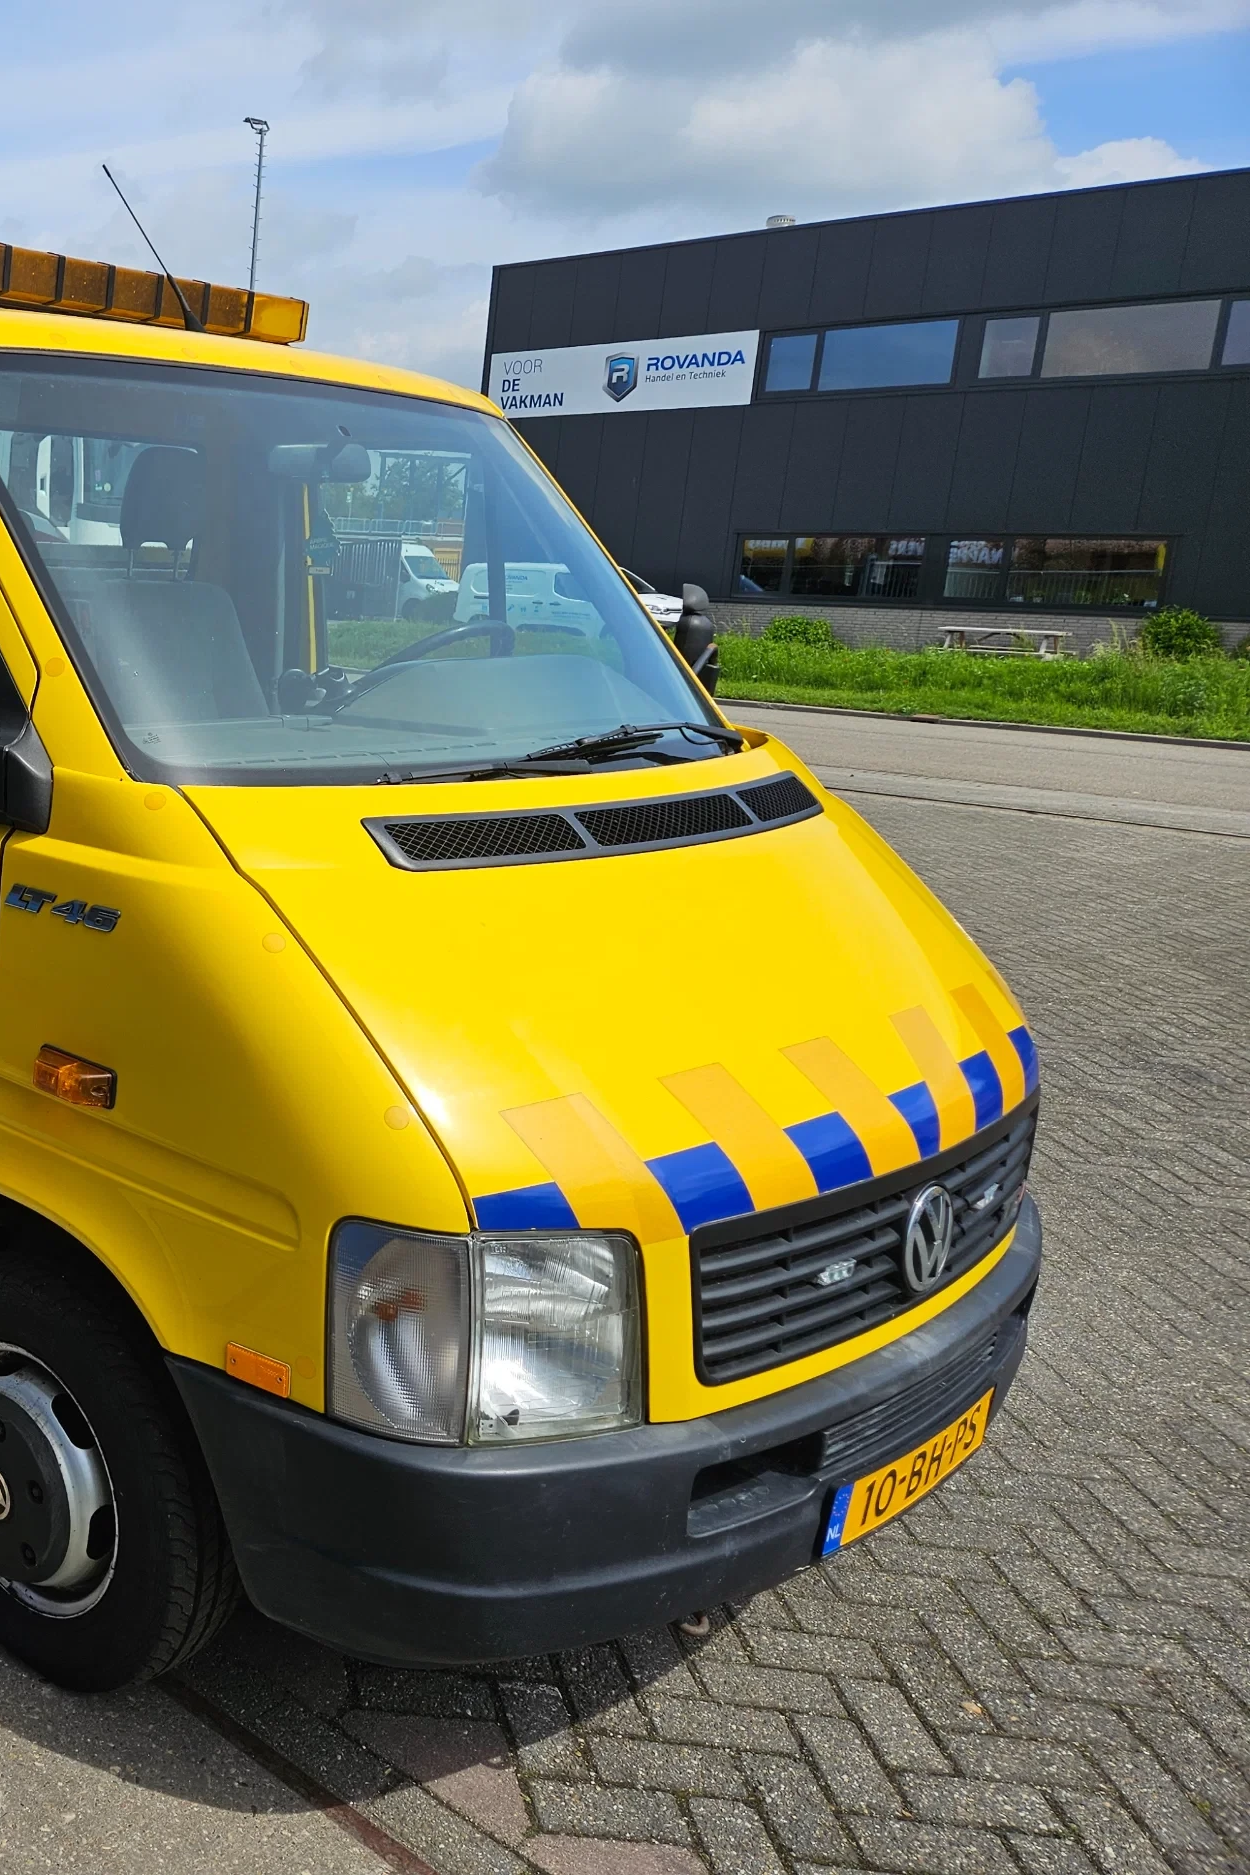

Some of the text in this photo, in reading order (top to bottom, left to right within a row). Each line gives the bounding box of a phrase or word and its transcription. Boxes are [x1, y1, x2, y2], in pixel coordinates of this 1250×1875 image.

[503, 358, 543, 375] VOOR
[646, 350, 745, 371] ROVANDA
[612, 363, 630, 384] R
[645, 369, 726, 383] Handel en Techniek
[501, 378, 521, 392] DE
[500, 393, 564, 410] VAKMAN
[5, 883, 121, 932] LT 46
[860, 1404, 981, 1527] 10-BH-PS
[826, 1524, 841, 1543] NL
